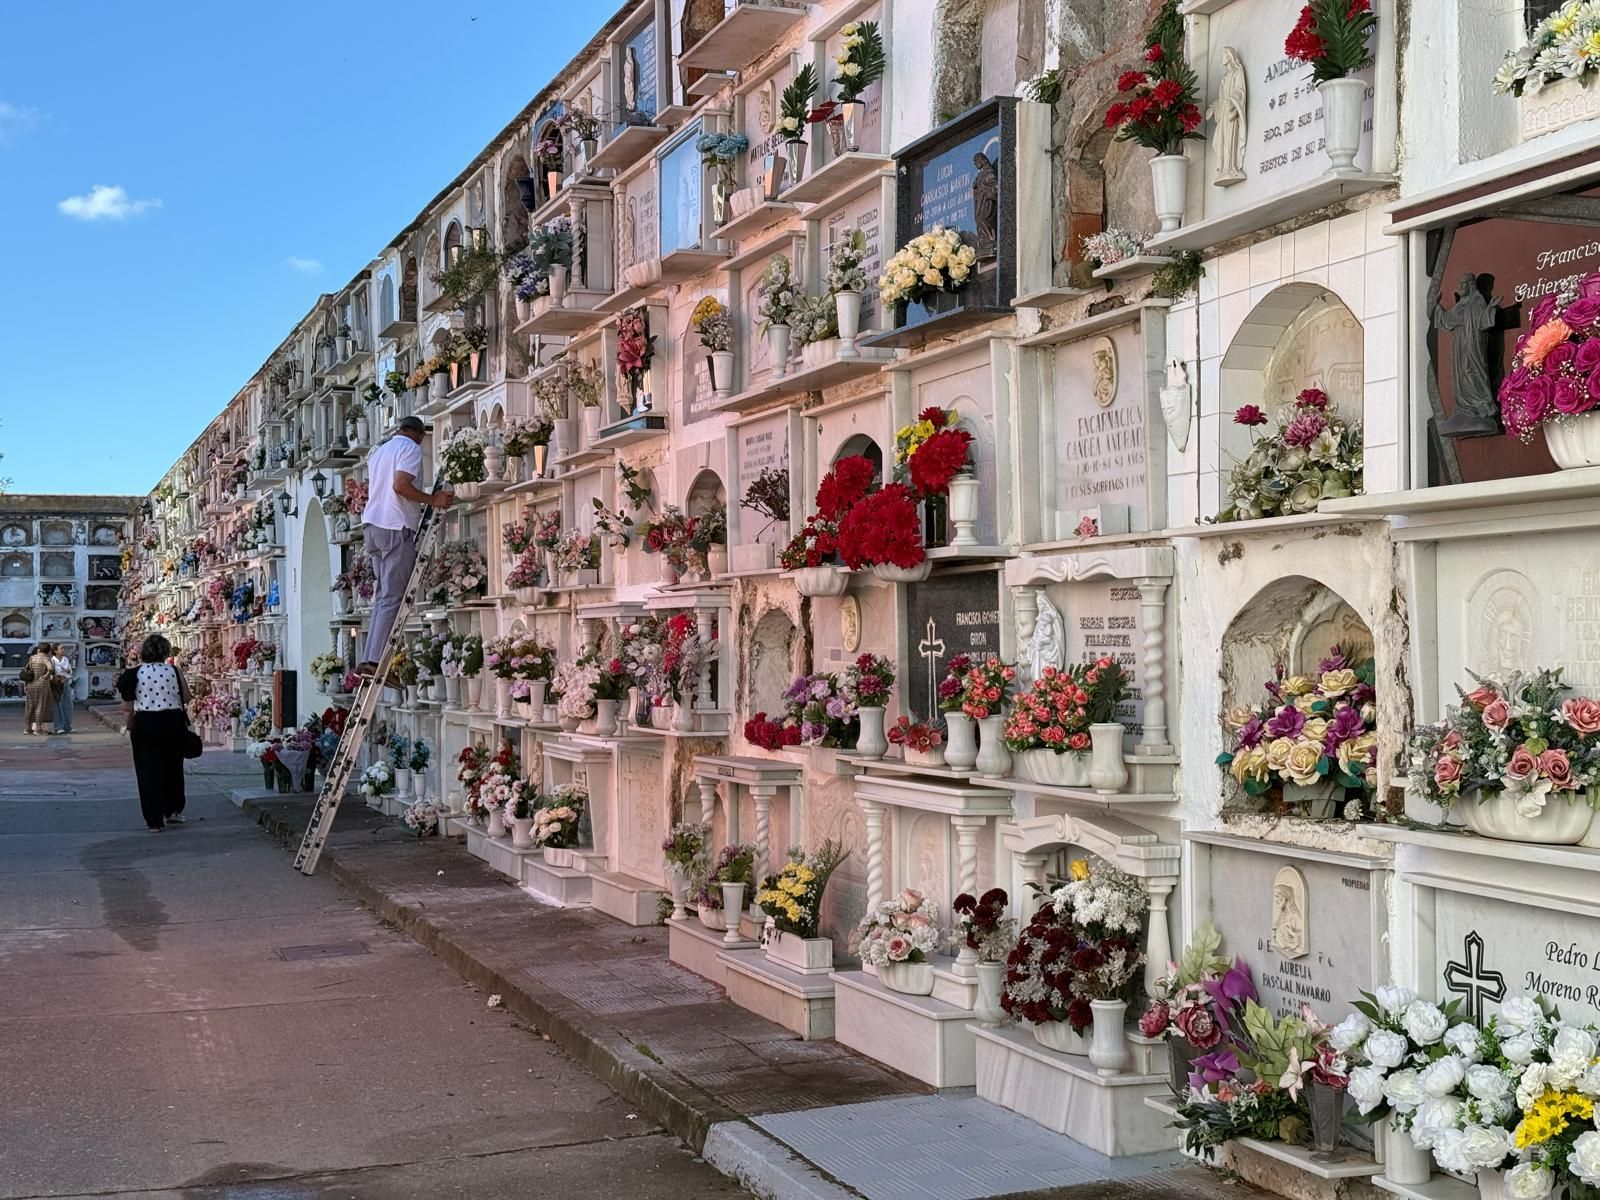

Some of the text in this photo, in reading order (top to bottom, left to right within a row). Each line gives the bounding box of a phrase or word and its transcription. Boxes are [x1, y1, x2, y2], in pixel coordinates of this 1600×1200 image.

[1545, 940, 1588, 968] Pedro
[1279, 960, 1313, 980] AURELIA
[1295, 981, 1332, 1003] NAVARRO
[1524, 970, 1582, 1002] Moreno
